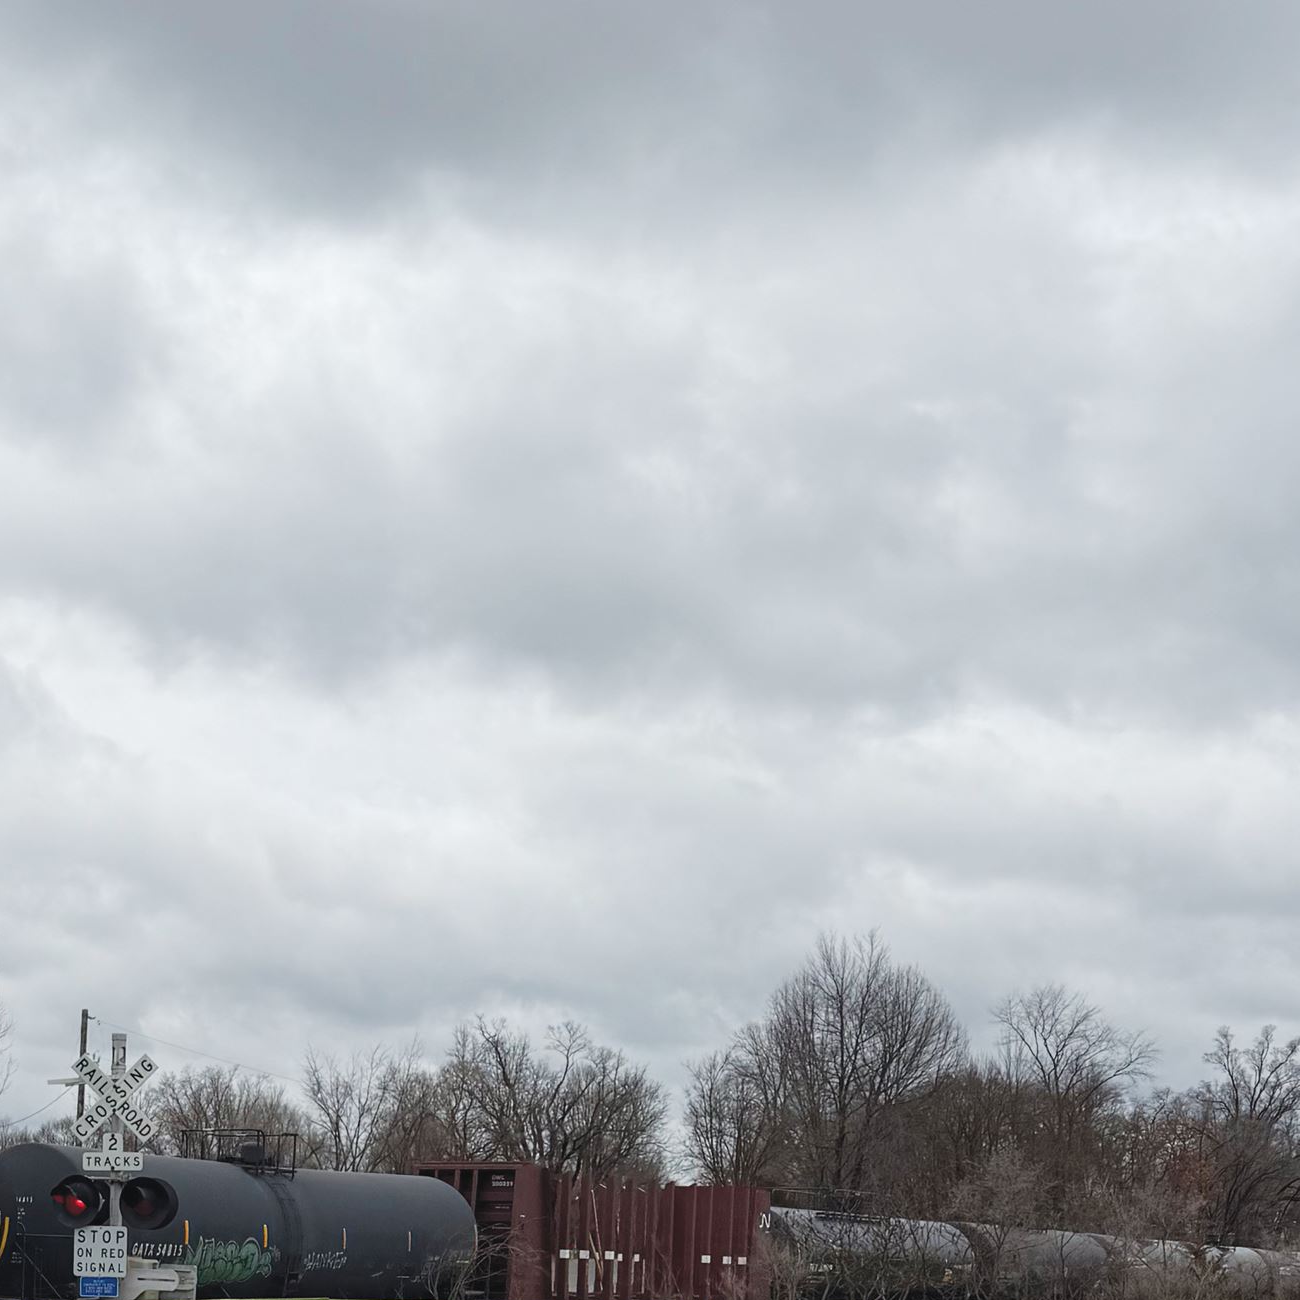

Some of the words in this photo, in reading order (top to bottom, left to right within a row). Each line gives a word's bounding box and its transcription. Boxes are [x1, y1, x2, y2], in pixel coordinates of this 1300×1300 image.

[108, 1137, 118, 1151] 2
[86, 1156, 140, 1167] TRACKS
[77, 1229, 125, 1244] STOP
[77, 1247, 93, 1258] ON
[101, 1248, 125, 1259] RED
[131, 1242, 155, 1257] GATX
[77, 1262, 125, 1274] SIGNAL
